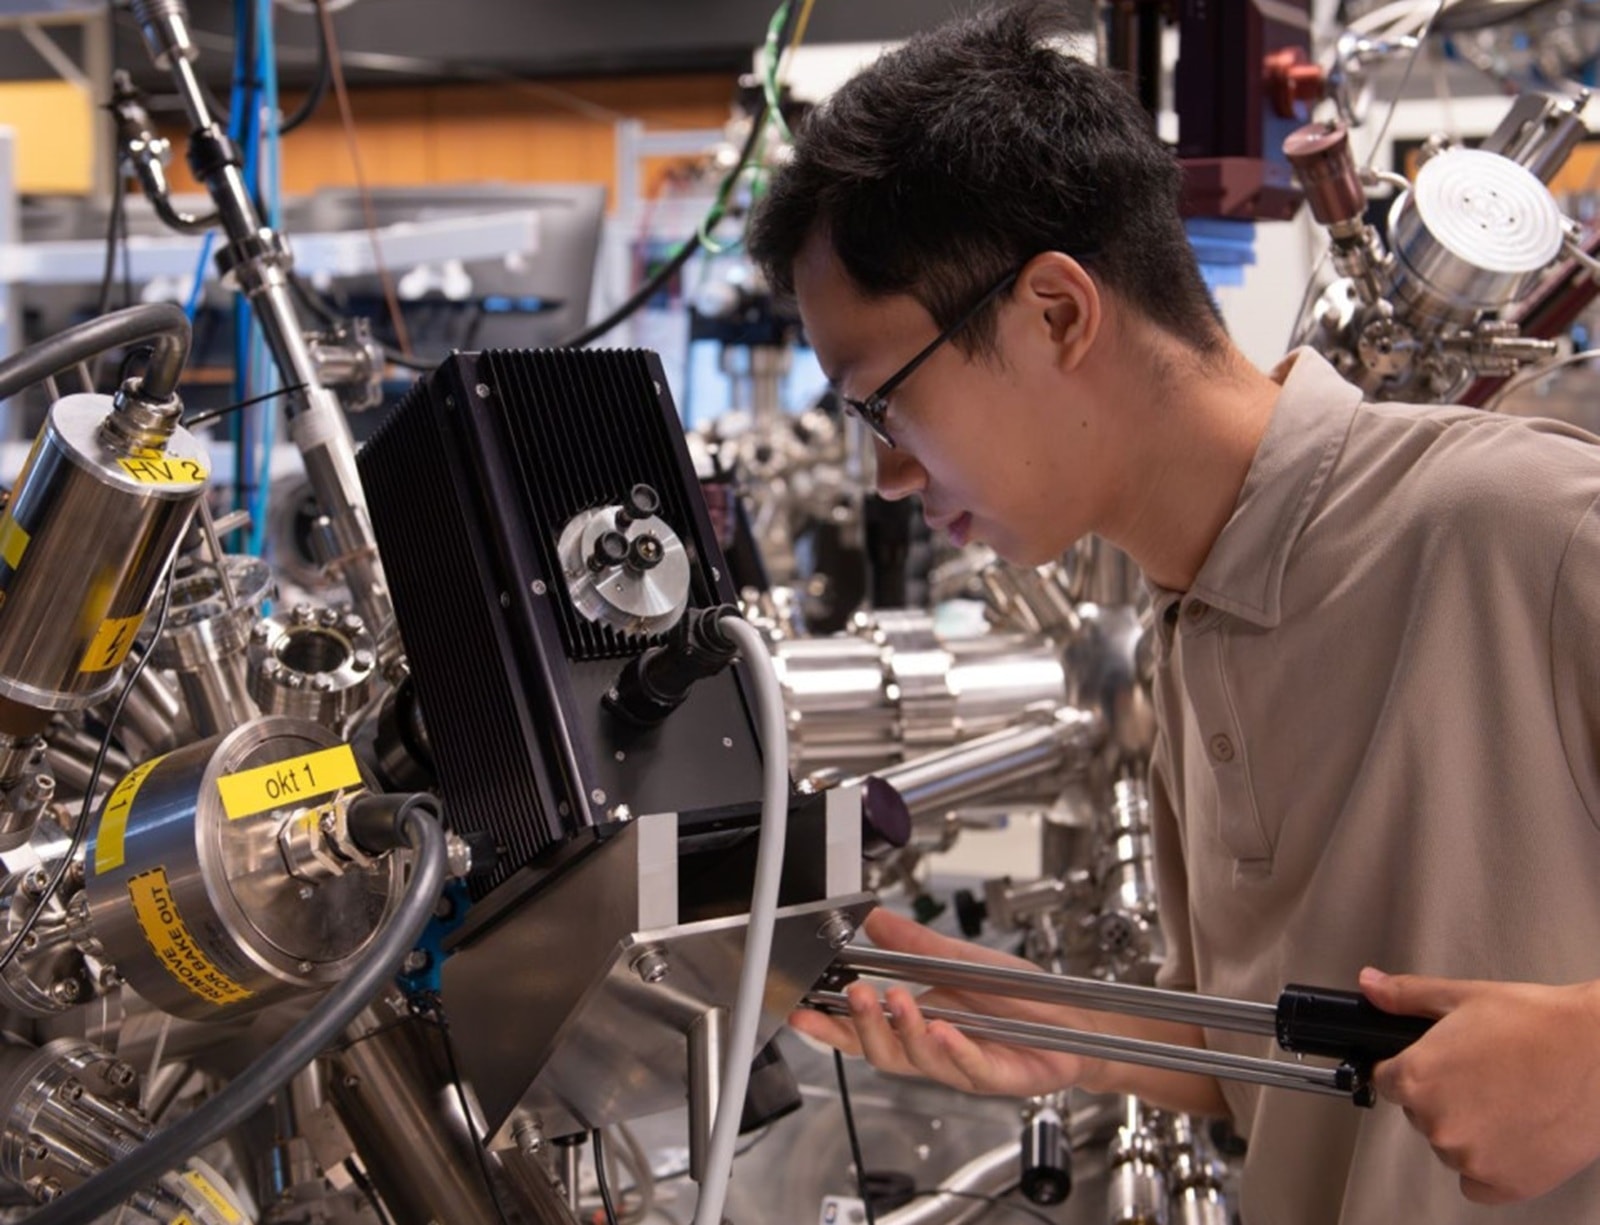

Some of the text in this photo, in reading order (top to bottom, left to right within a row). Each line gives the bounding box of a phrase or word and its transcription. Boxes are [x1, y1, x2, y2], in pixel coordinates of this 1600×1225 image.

[122, 461, 206, 480] HV 2
[265, 762, 316, 800] okt 1
[151, 886, 174, 925] OUT
[168, 927, 207, 972] BAKE
[162, 946, 224, 999] REMOVE
[204, 971, 239, 995] FOR
